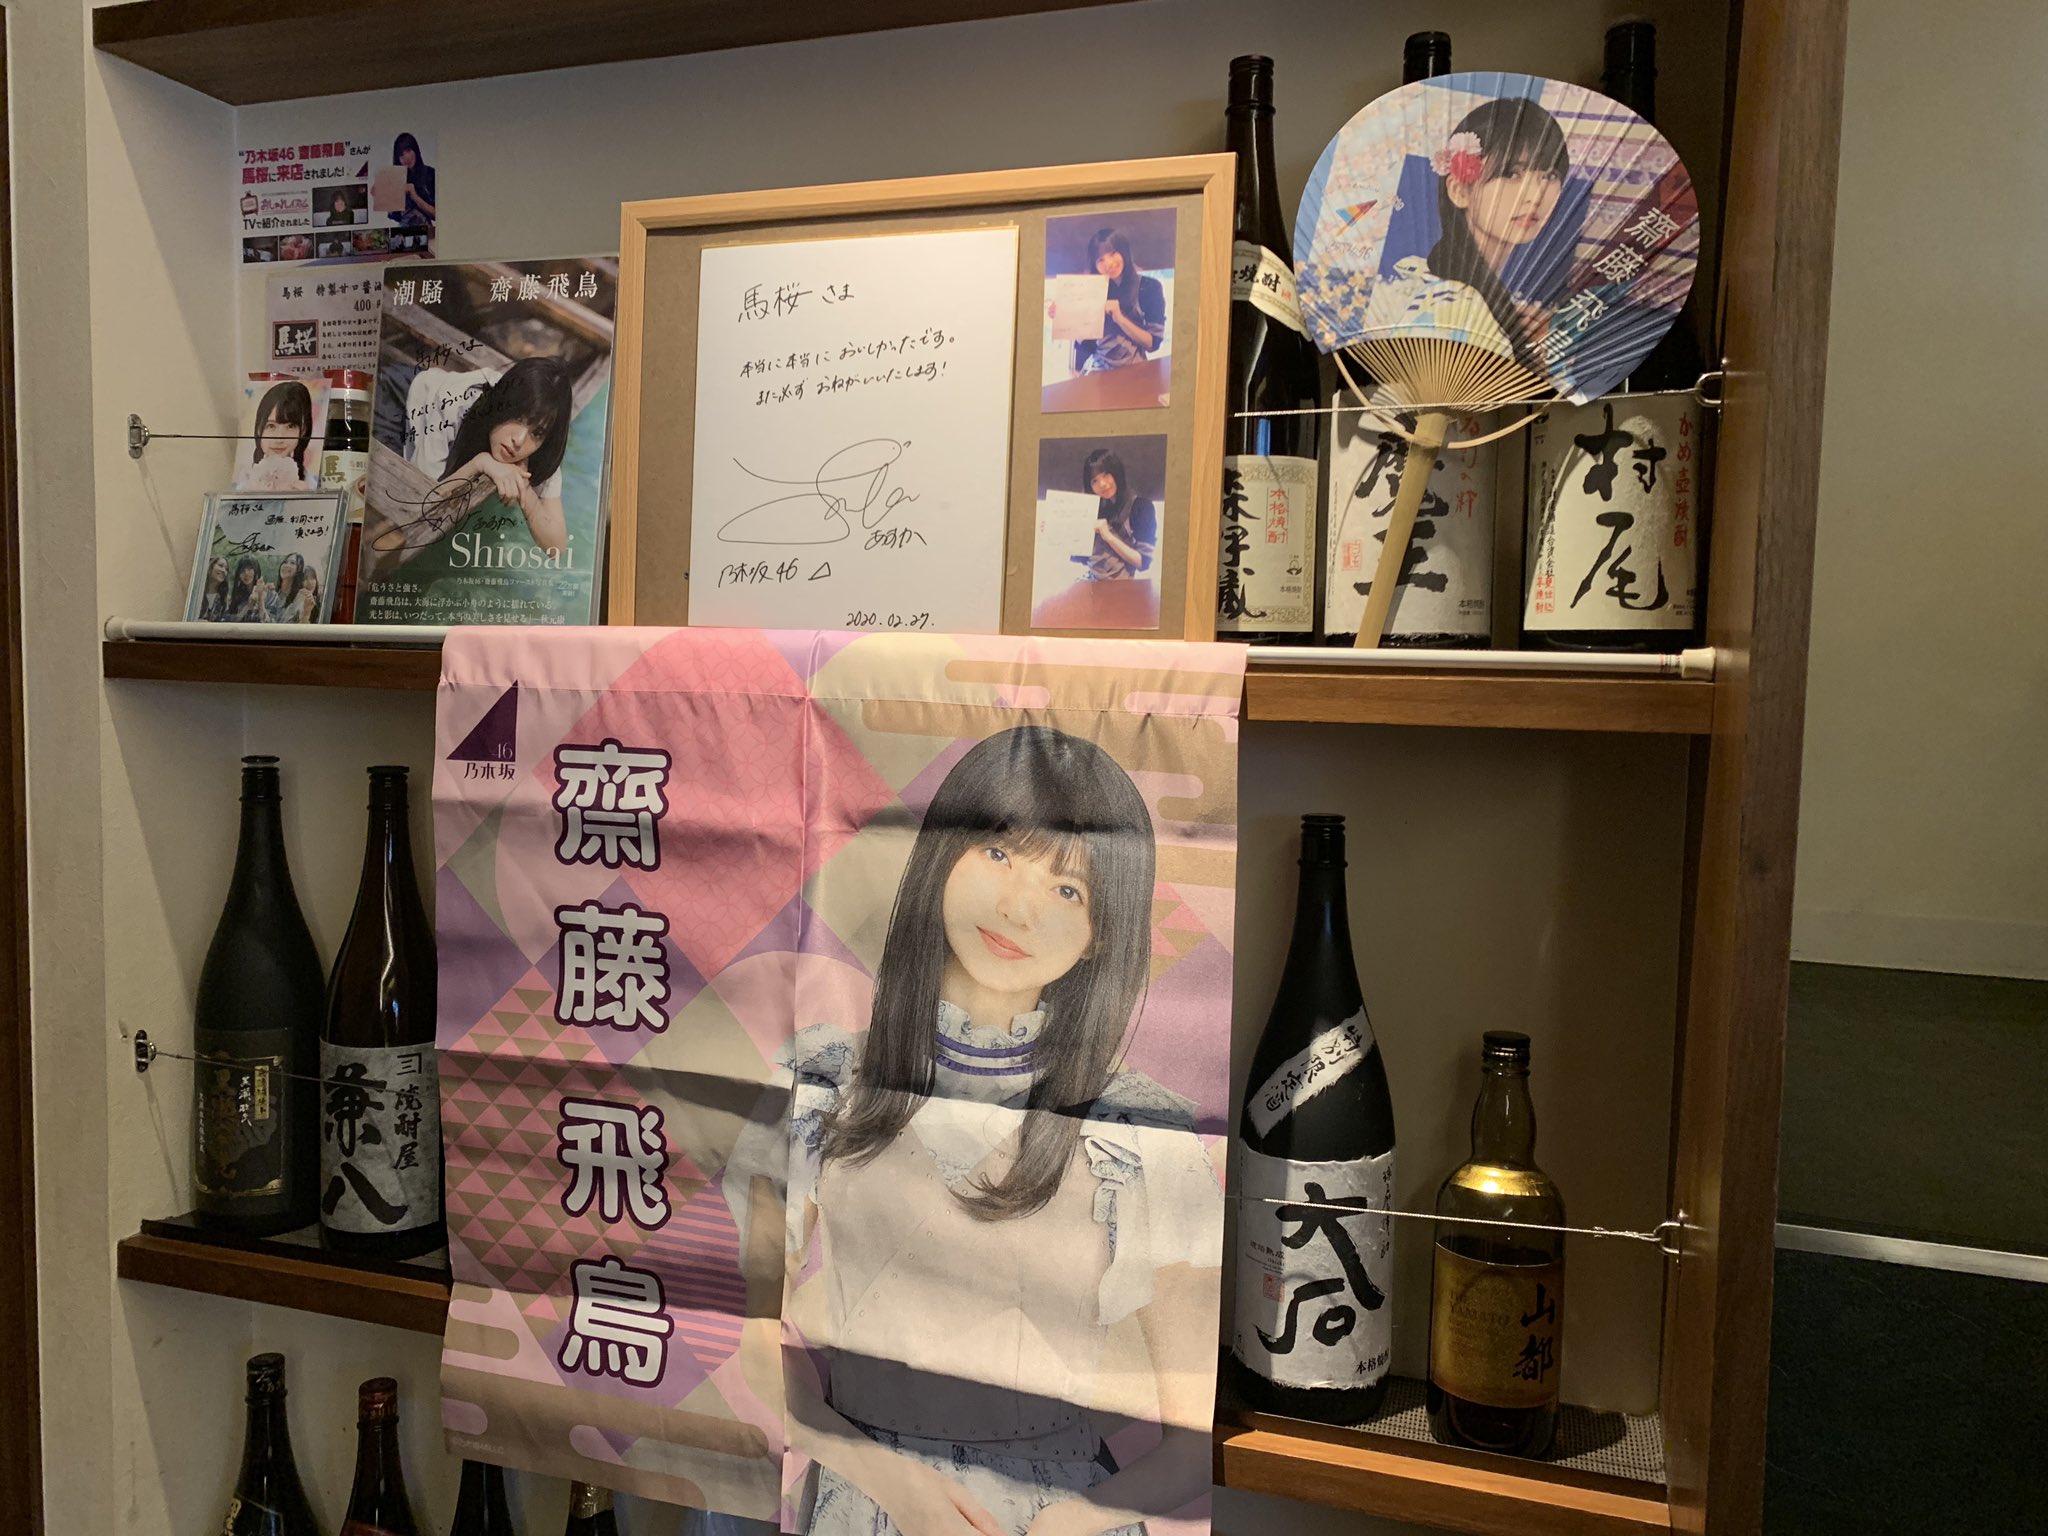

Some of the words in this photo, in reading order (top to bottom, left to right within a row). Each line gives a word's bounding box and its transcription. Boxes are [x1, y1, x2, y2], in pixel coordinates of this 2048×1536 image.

[354, 299, 372, 312] 400
[393, 279, 444, 306] 潮騒
[489, 271, 598, 303] 齋藤飛鳥
[322, 455, 347, 484] 馬
[1268, 487, 1288, 544] 本格焼酎
[1570, 403, 1669, 611] 村尾
[449, 532, 574, 569] Shiosai
[464, 762, 516, 780] 乃木坂
[552, 738, 675, 1388] 齋藤飛鳥
[321, 1062, 409, 1226] 兼八
[1254, 1181, 1388, 1355] 大石
[1511, 1282, 1556, 1385] 山都
